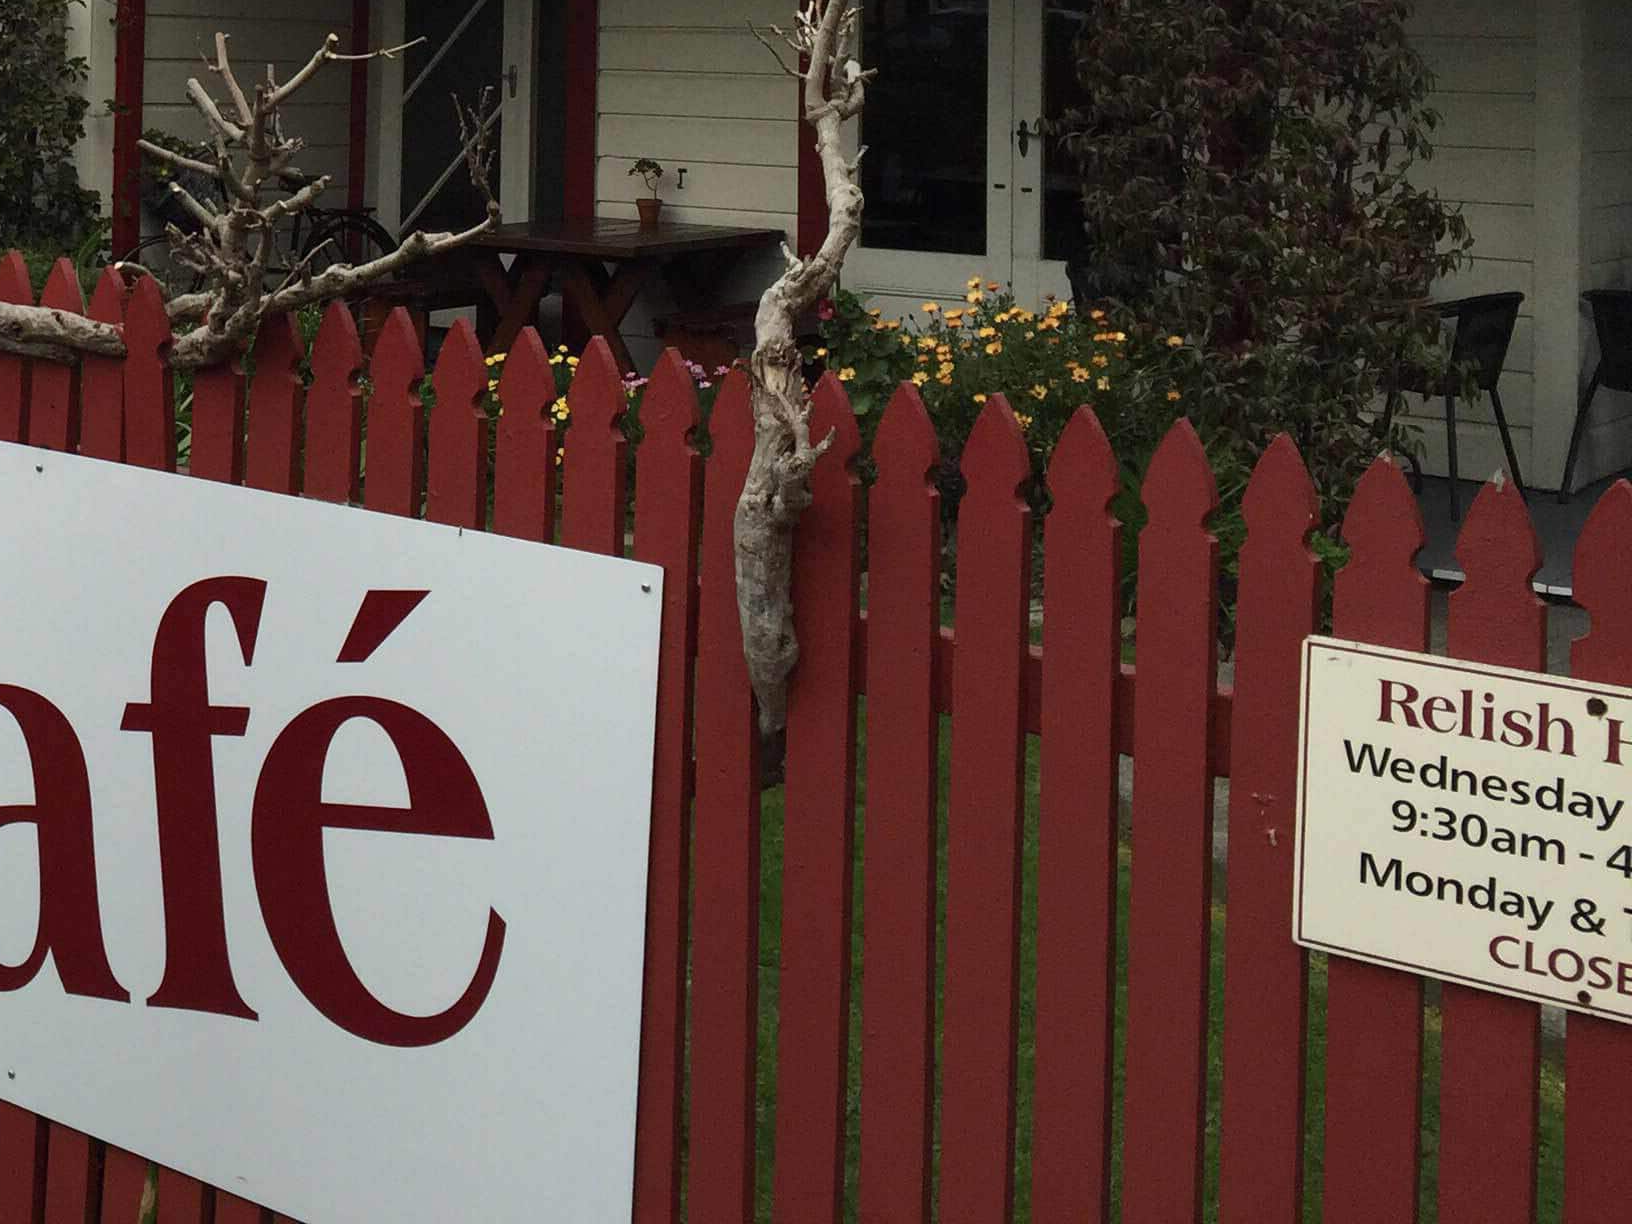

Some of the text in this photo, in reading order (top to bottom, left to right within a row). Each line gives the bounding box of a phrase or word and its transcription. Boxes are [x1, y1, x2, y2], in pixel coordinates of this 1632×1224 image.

[1376, 678, 1577, 757] Relish
[1343, 738, 1624, 831] Wednesday
[1391, 799, 1566, 865] 9:30am
[1606, 844, 1632, 879] 4
[1359, 852, 1554, 931] Monday
[1570, 898, 1606, 937] &
[1488, 935, 1632, 997] CLOSE
